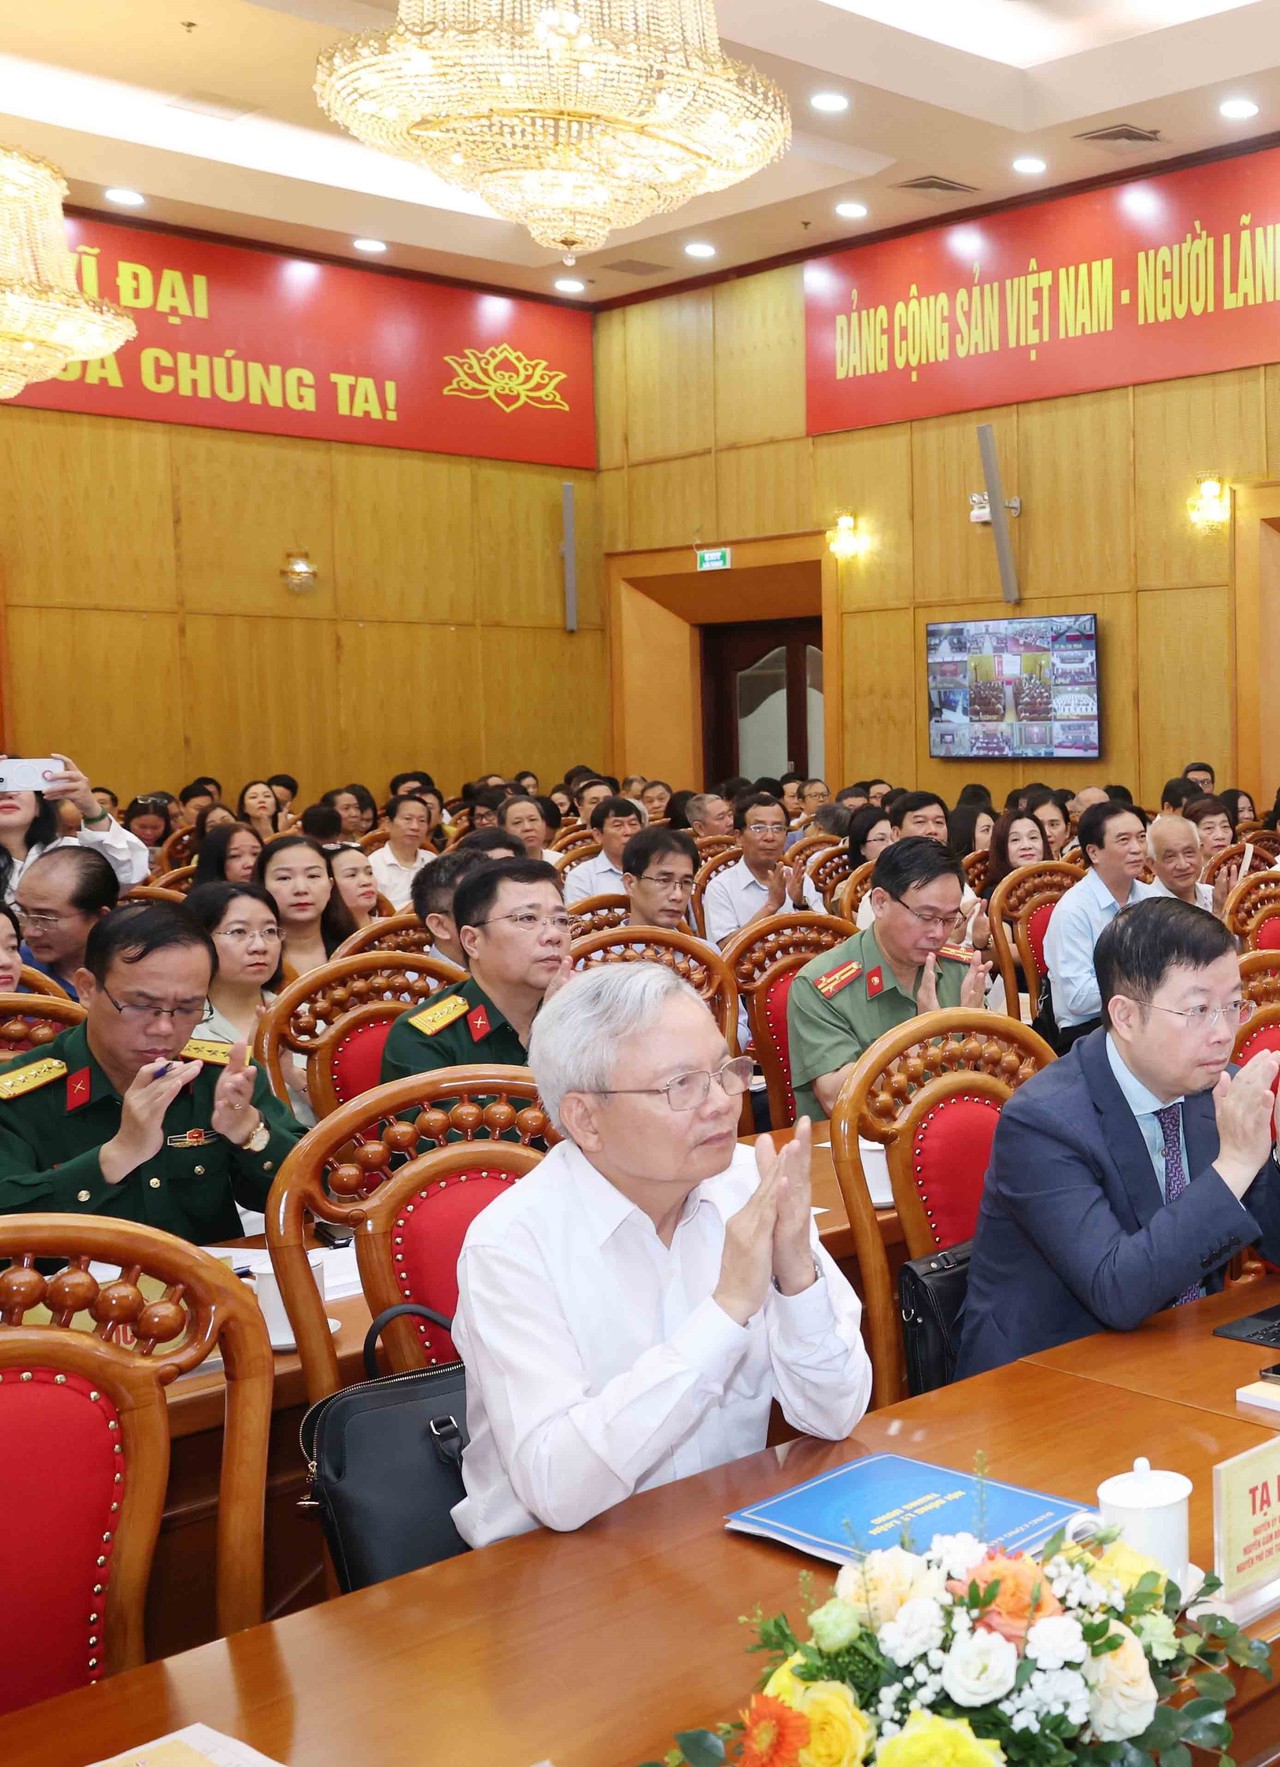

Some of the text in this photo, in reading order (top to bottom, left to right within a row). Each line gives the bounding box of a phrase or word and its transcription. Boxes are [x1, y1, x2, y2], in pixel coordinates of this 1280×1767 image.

[115, 261, 209, 325] ĐẠI
[836, 288, 888, 380] ĐẢNG
[893, 284, 950, 382] CỘNG
[955, 261, 1000, 358] SẢN
[1005, 258, 1053, 361] VIỆT
[1058, 258, 1113, 339] NAM
[1137, 220, 1214, 325] NGƯỜI
[140, 347, 316, 412] CHÚNG
[329, 373, 397, 422] TA!
[1248, 1480, 1271, 1517] TẠ
